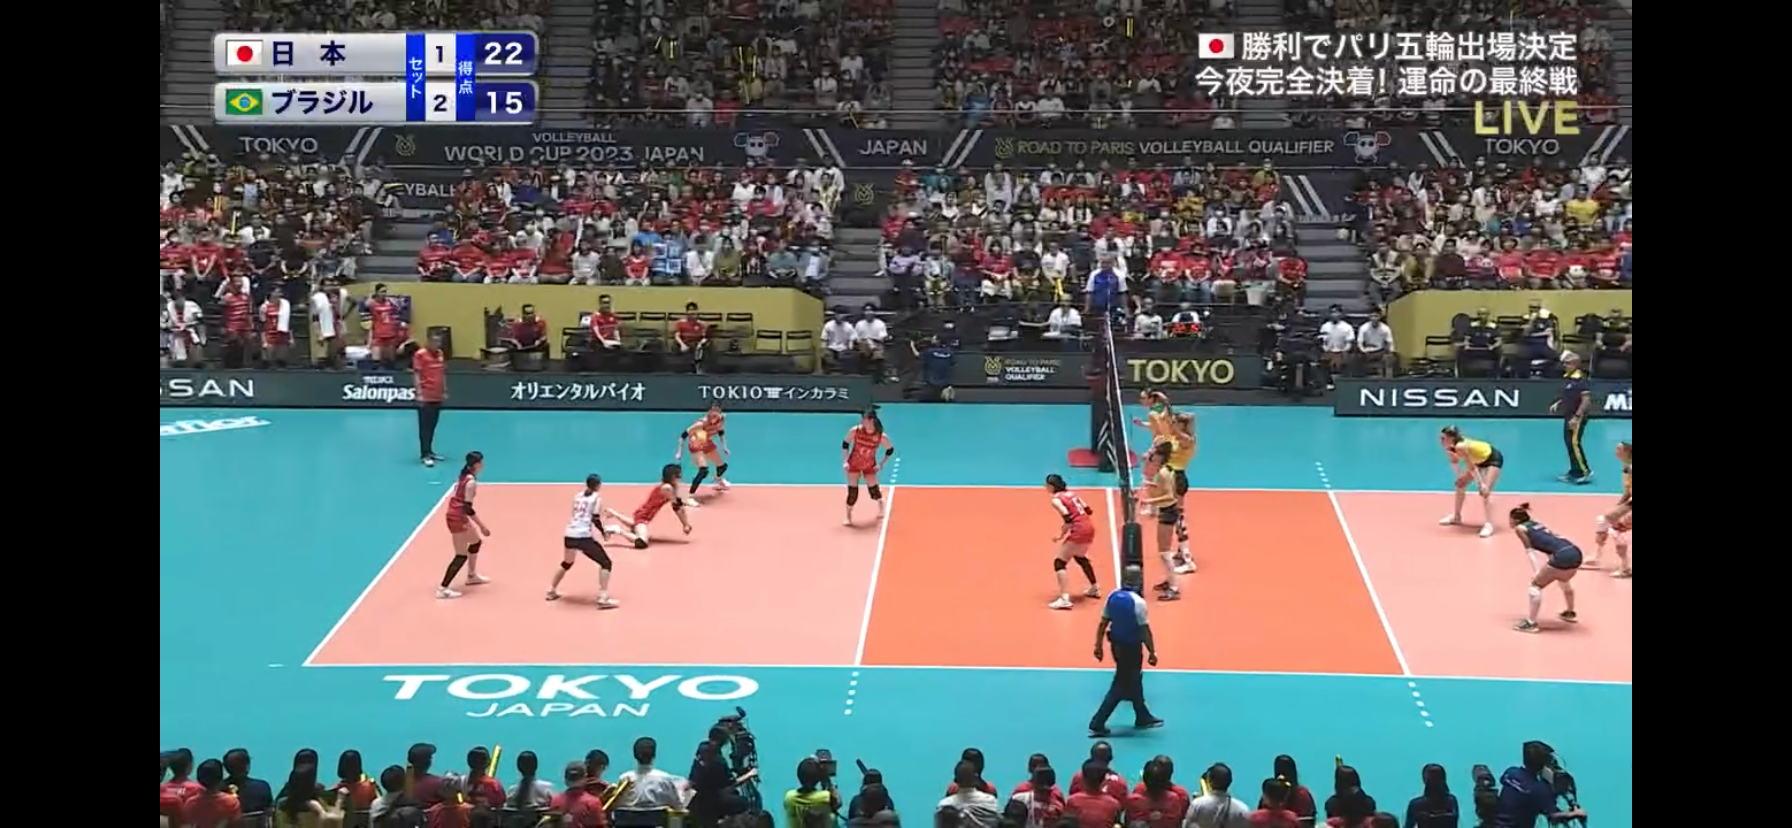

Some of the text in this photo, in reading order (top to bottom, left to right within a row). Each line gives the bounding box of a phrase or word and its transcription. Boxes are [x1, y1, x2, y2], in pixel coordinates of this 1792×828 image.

[238, 136, 318, 153] TOKYO
[532, 132, 617, 143] VOLLEYBALL
[444, 145, 704, 161] WORLD CUP 2023 JAPAN
[860, 139, 927, 155] JAPAN
[1018, 140, 1335, 155] ROAD TO PARIS VOLLEYBALL QUALIFIER
[1485, 138, 1560, 155] TOKYO
[1127, 359, 1235, 384] TOKYO
[160, 379, 254, 397] SAN
[342, 384, 417, 403] Salonpas
[510, 382, 646, 400] オリエンタルバイオ
[698, 385, 763, 399] TOKIO
[1360, 389, 1520, 407] NISSAN
[383, 673, 759, 700] TOKYO
[466, 702, 650, 718] JAPAN
